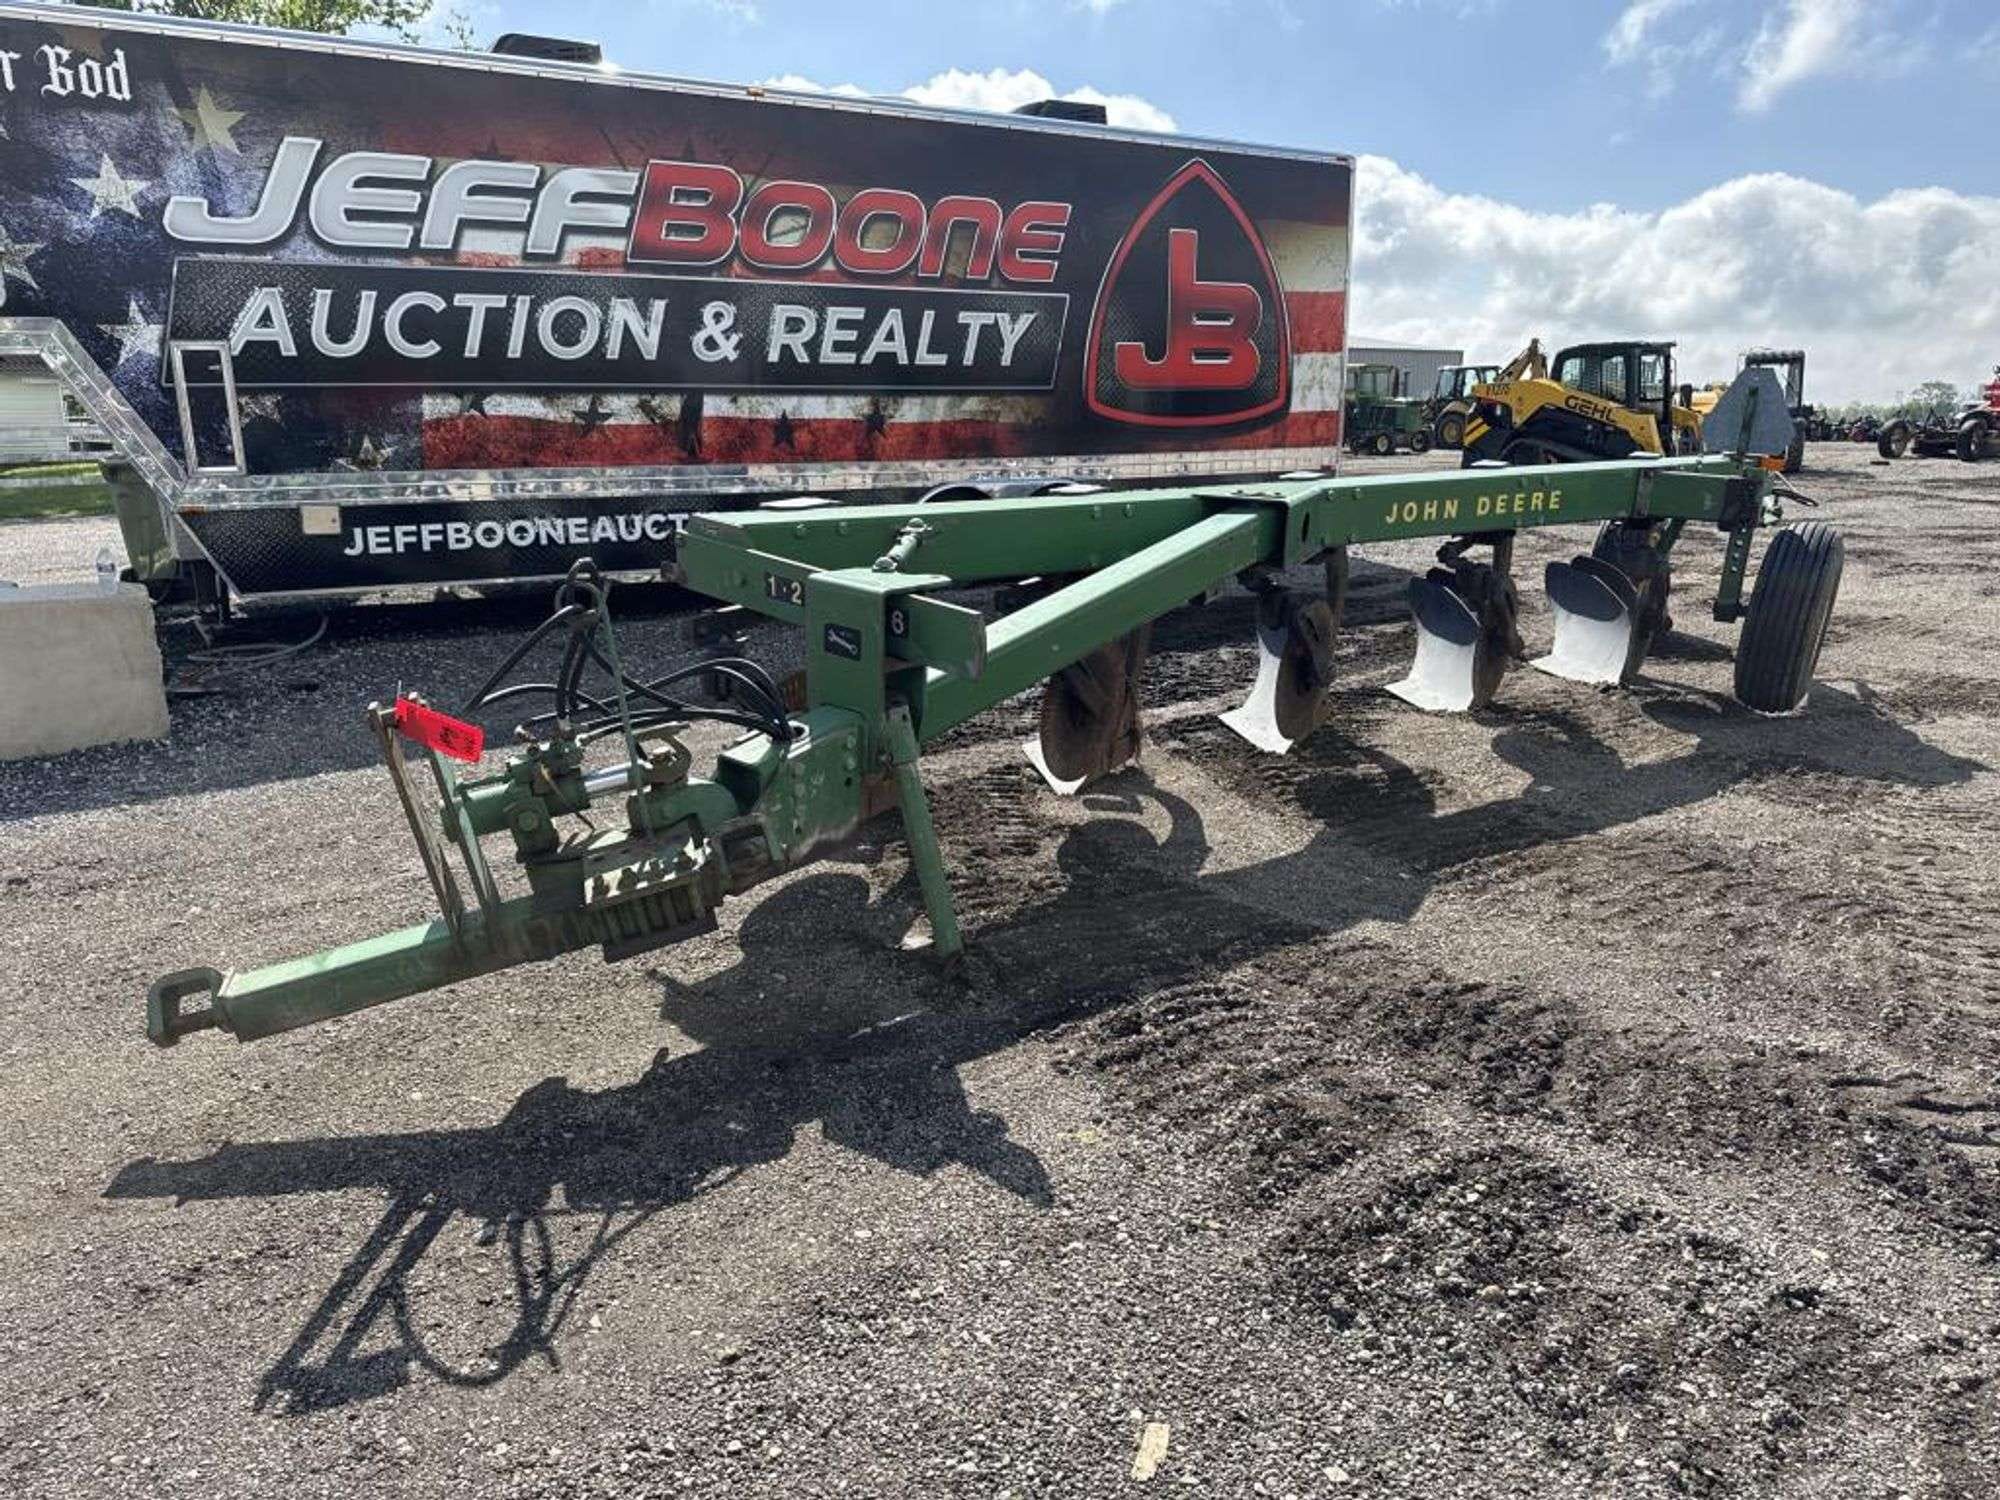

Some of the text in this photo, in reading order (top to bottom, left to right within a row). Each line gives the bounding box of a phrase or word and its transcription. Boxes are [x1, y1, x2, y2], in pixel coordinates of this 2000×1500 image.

[230, 287, 1037, 366] AUCTION & REALTY
[1564, 394, 1616, 422] GEHL
[1385, 489, 1563, 525] JOHN DEERE
